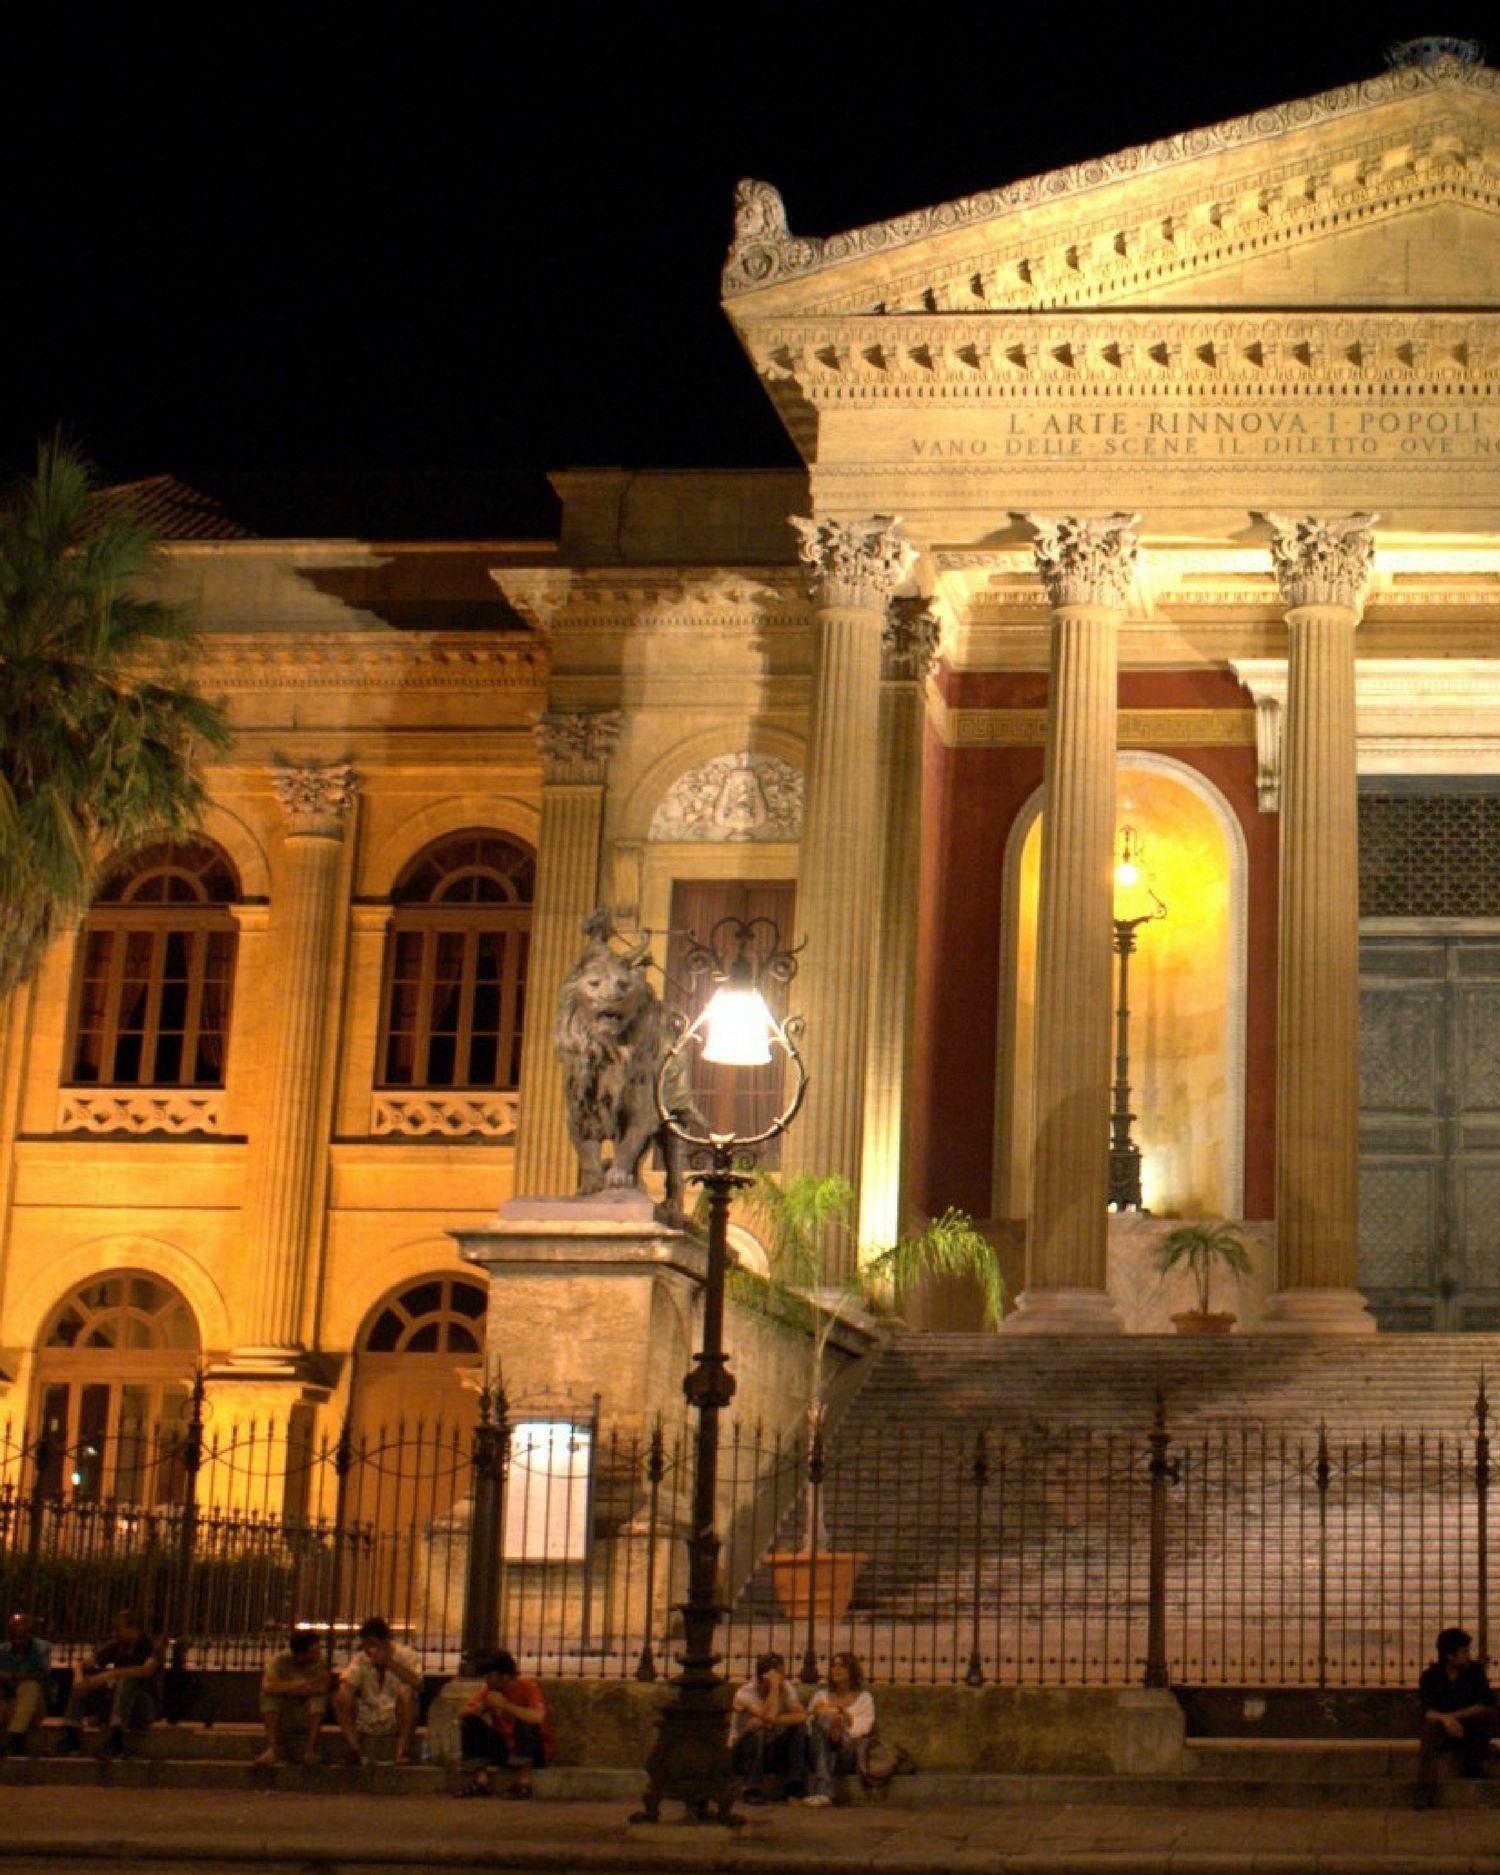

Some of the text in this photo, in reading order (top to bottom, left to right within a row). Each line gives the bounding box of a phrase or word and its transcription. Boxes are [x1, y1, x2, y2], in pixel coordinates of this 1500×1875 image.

[1009, 412, 1128, 435] L'ARTE
[1149, 412, 1308, 435] RINNOVA
[1327, 412, 1336, 434] I
[1360, 411, 1479, 434] POPOLI
[912, 438, 987, 456] VANO
[1005, 437, 1083, 456] DELLE
[1105, 437, 1198, 455] SCENE
[1218, 436, 1245, 455] IL
[1263, 436, 1378, 455] DILETTO
[1400, 436, 1454, 454] OVE
